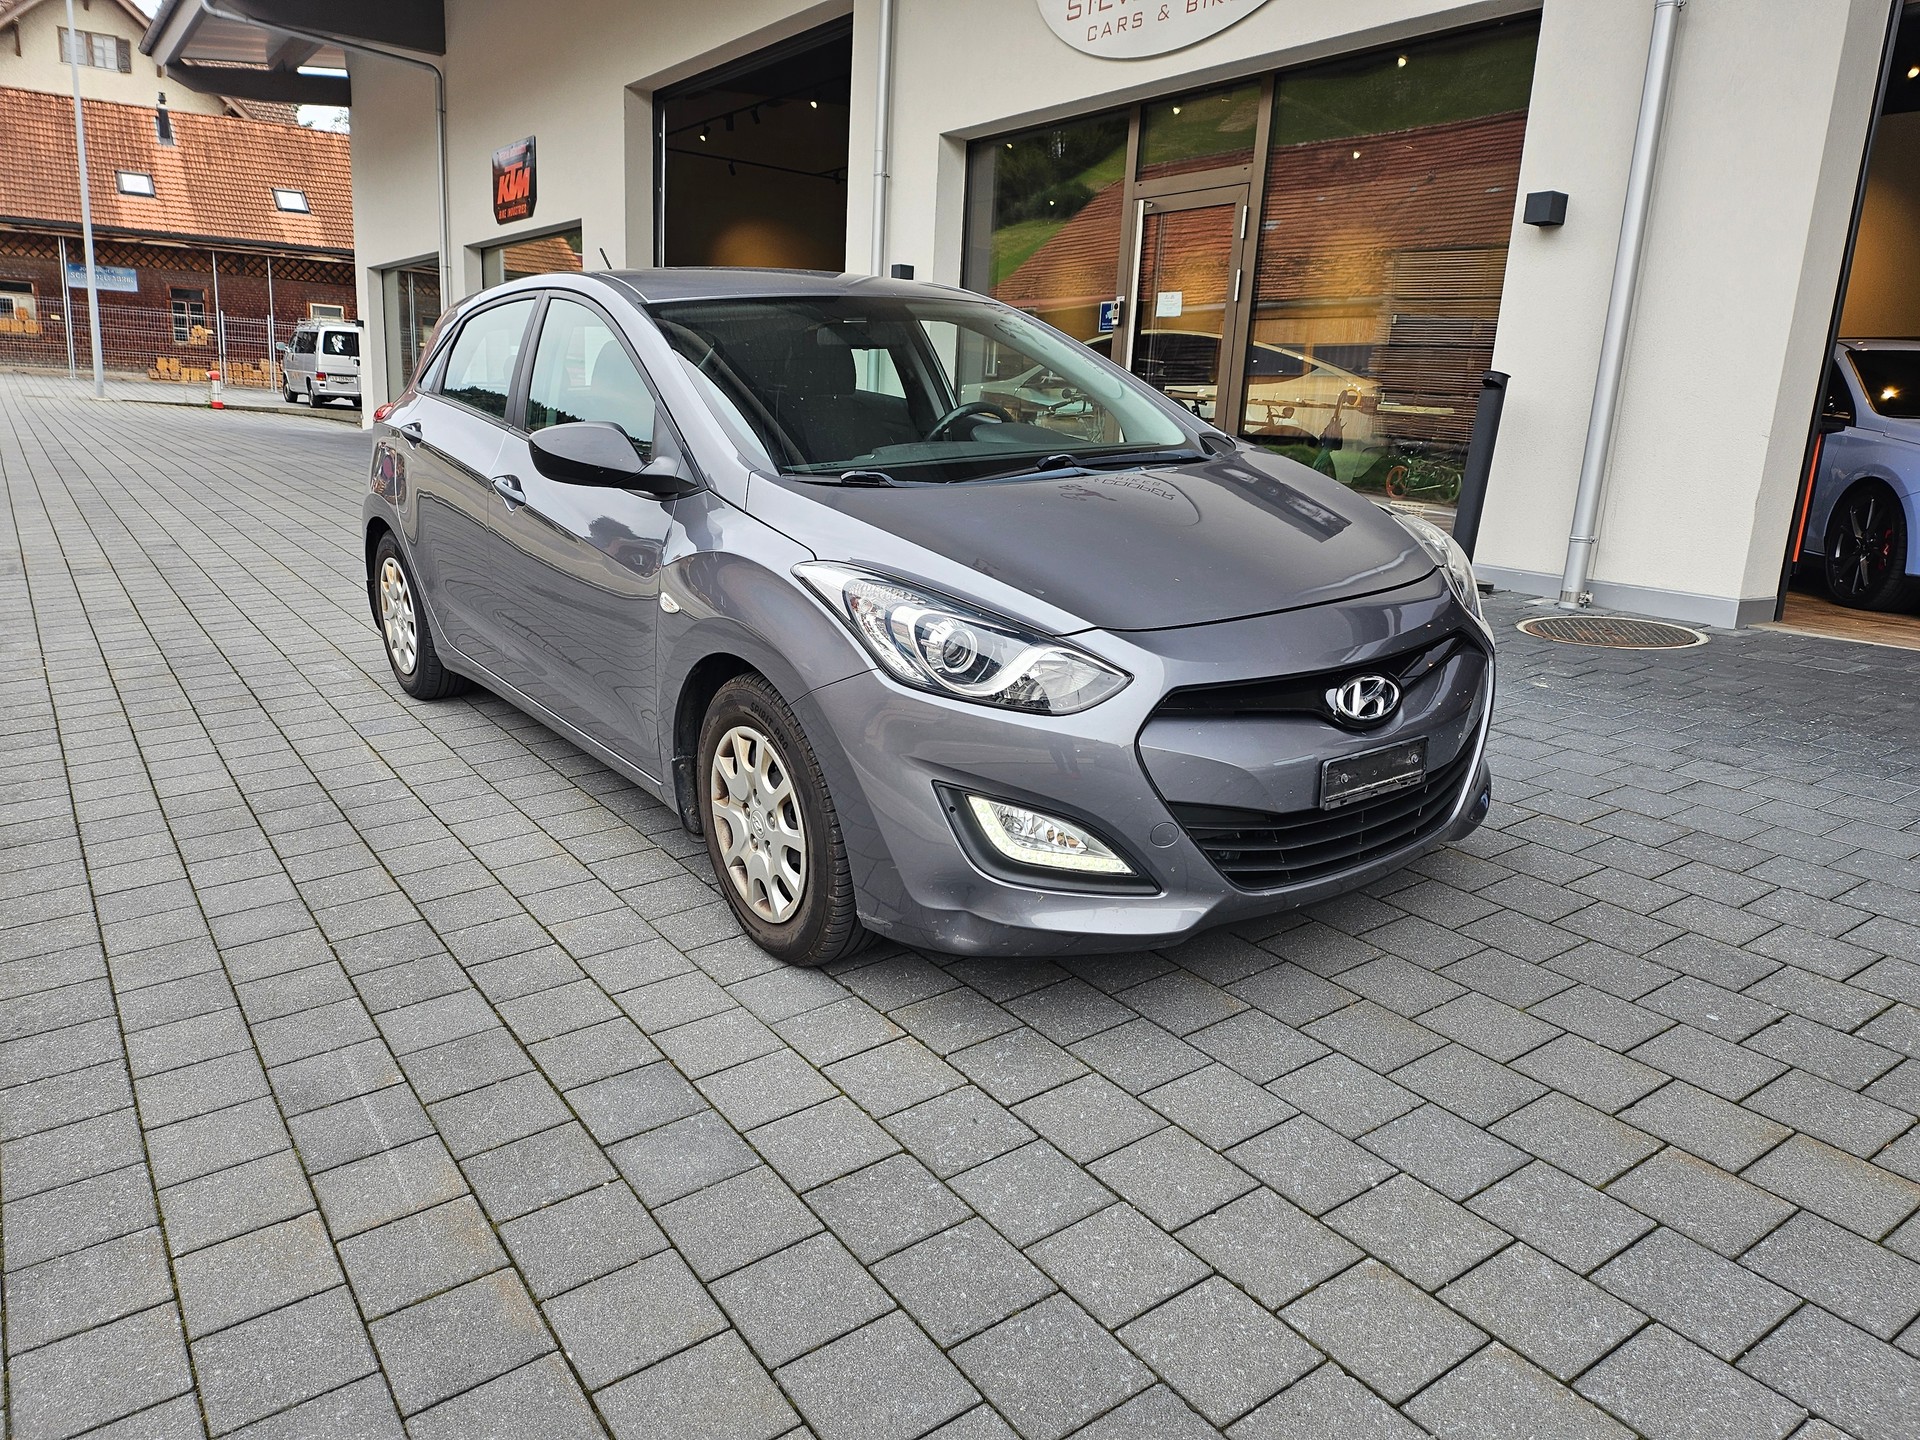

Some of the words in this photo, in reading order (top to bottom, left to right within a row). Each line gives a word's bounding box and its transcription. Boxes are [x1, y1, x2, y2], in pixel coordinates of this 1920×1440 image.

[1088, 11, 1142, 41] CARS
[1158, 4, 1169, 21] &
[497, 161, 530, 204] KTM
[750, 702, 773, 726] SPIRIT
[774, 728, 789, 750] PRO
